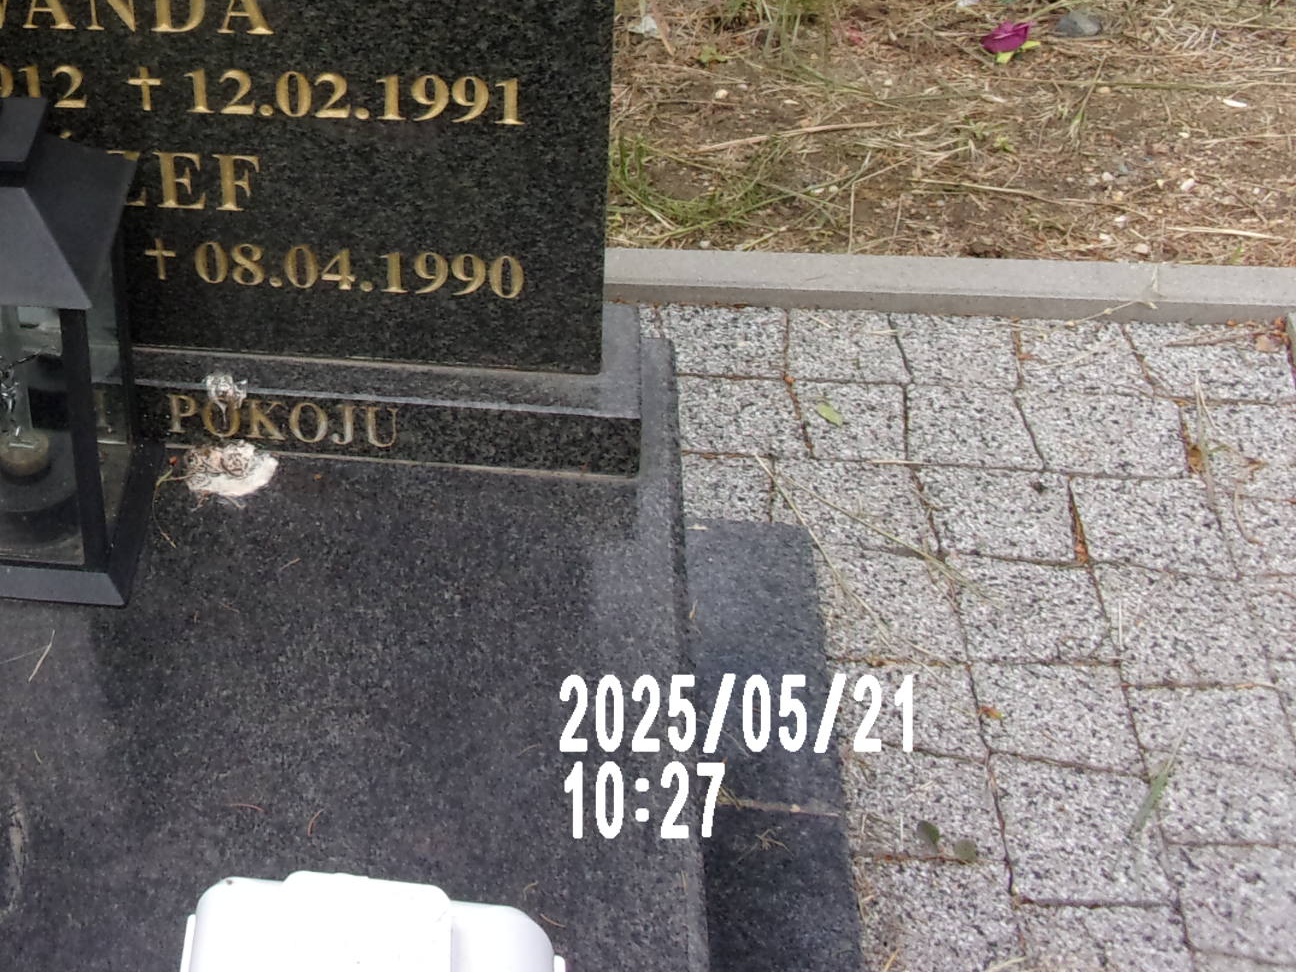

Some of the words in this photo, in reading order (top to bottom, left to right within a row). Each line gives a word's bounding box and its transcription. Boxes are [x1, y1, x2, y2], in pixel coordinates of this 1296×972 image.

[190, 67, 524, 127] 12.02.1991
[195, 240, 525, 301] 08.04.1990
[166, 393, 401, 448] POKOJU
